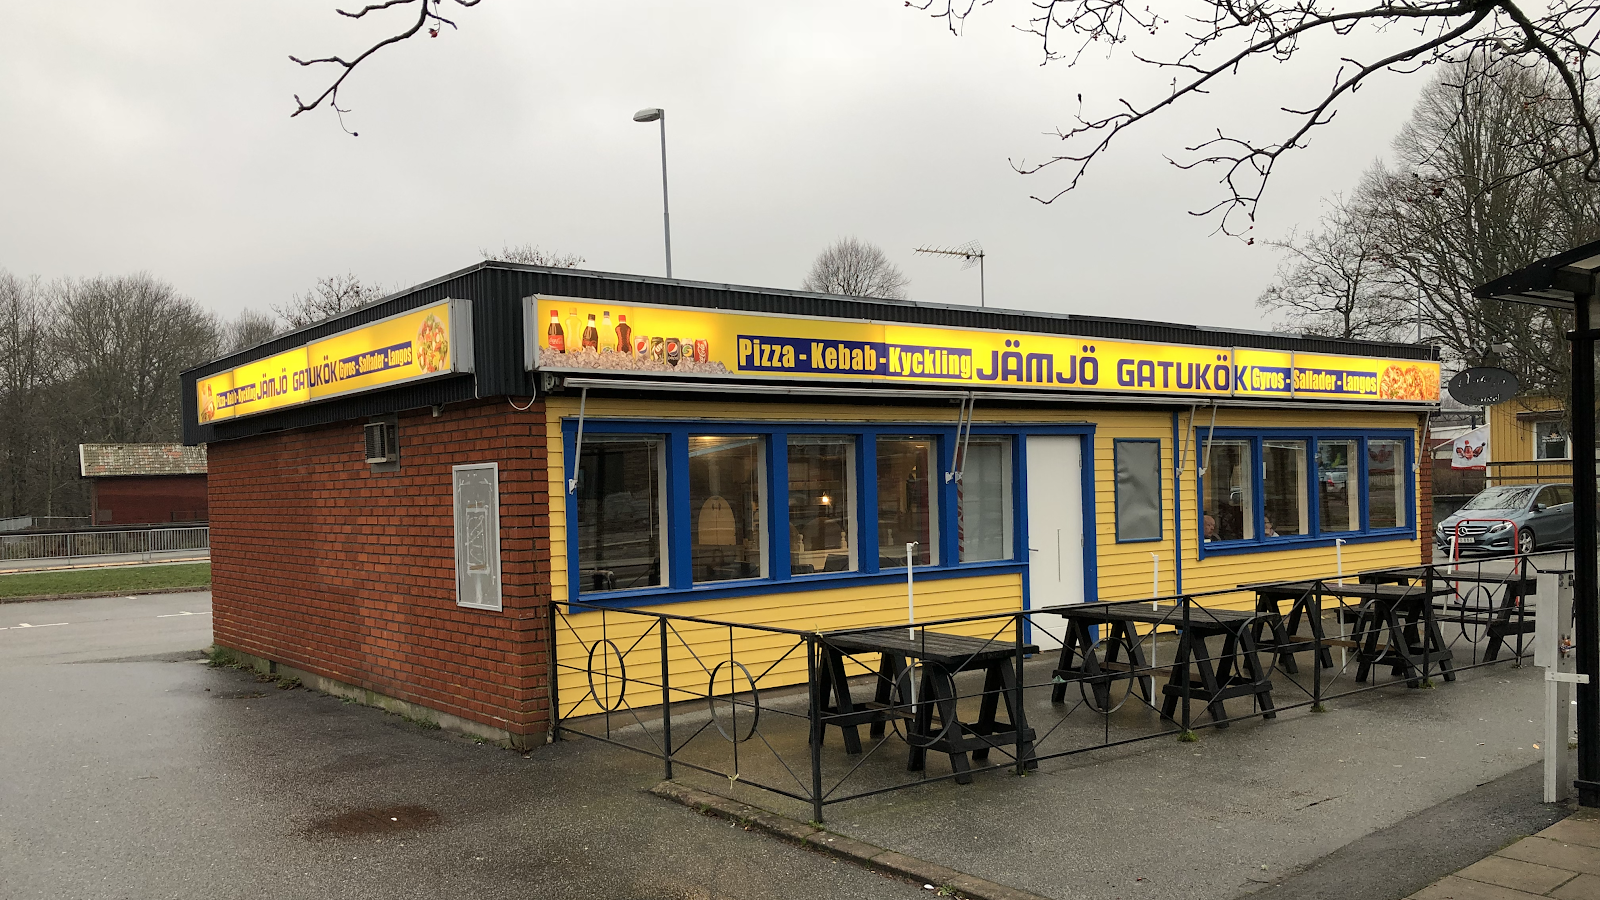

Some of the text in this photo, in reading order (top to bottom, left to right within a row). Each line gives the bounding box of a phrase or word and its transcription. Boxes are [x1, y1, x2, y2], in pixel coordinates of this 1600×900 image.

[256, 354, 338, 400] JÄMJÖ GATUKÖK
[339, 360, 356, 379] Gyros
[358, 352, 385, 374] Sallader
[387, 346, 412, 367] Langos
[738, 338, 795, 368] Pizza
[811, 342, 877, 371] Kebab
[889, 346, 972, 379] Kyckling
[976, 339, 1249, 391] JÄMJÖ GATUKÖK
[1252, 367, 1285, 391] Gyros
[1293, 369, 1337, 391] Sallader
[1342, 372, 1377, 394] Langos
